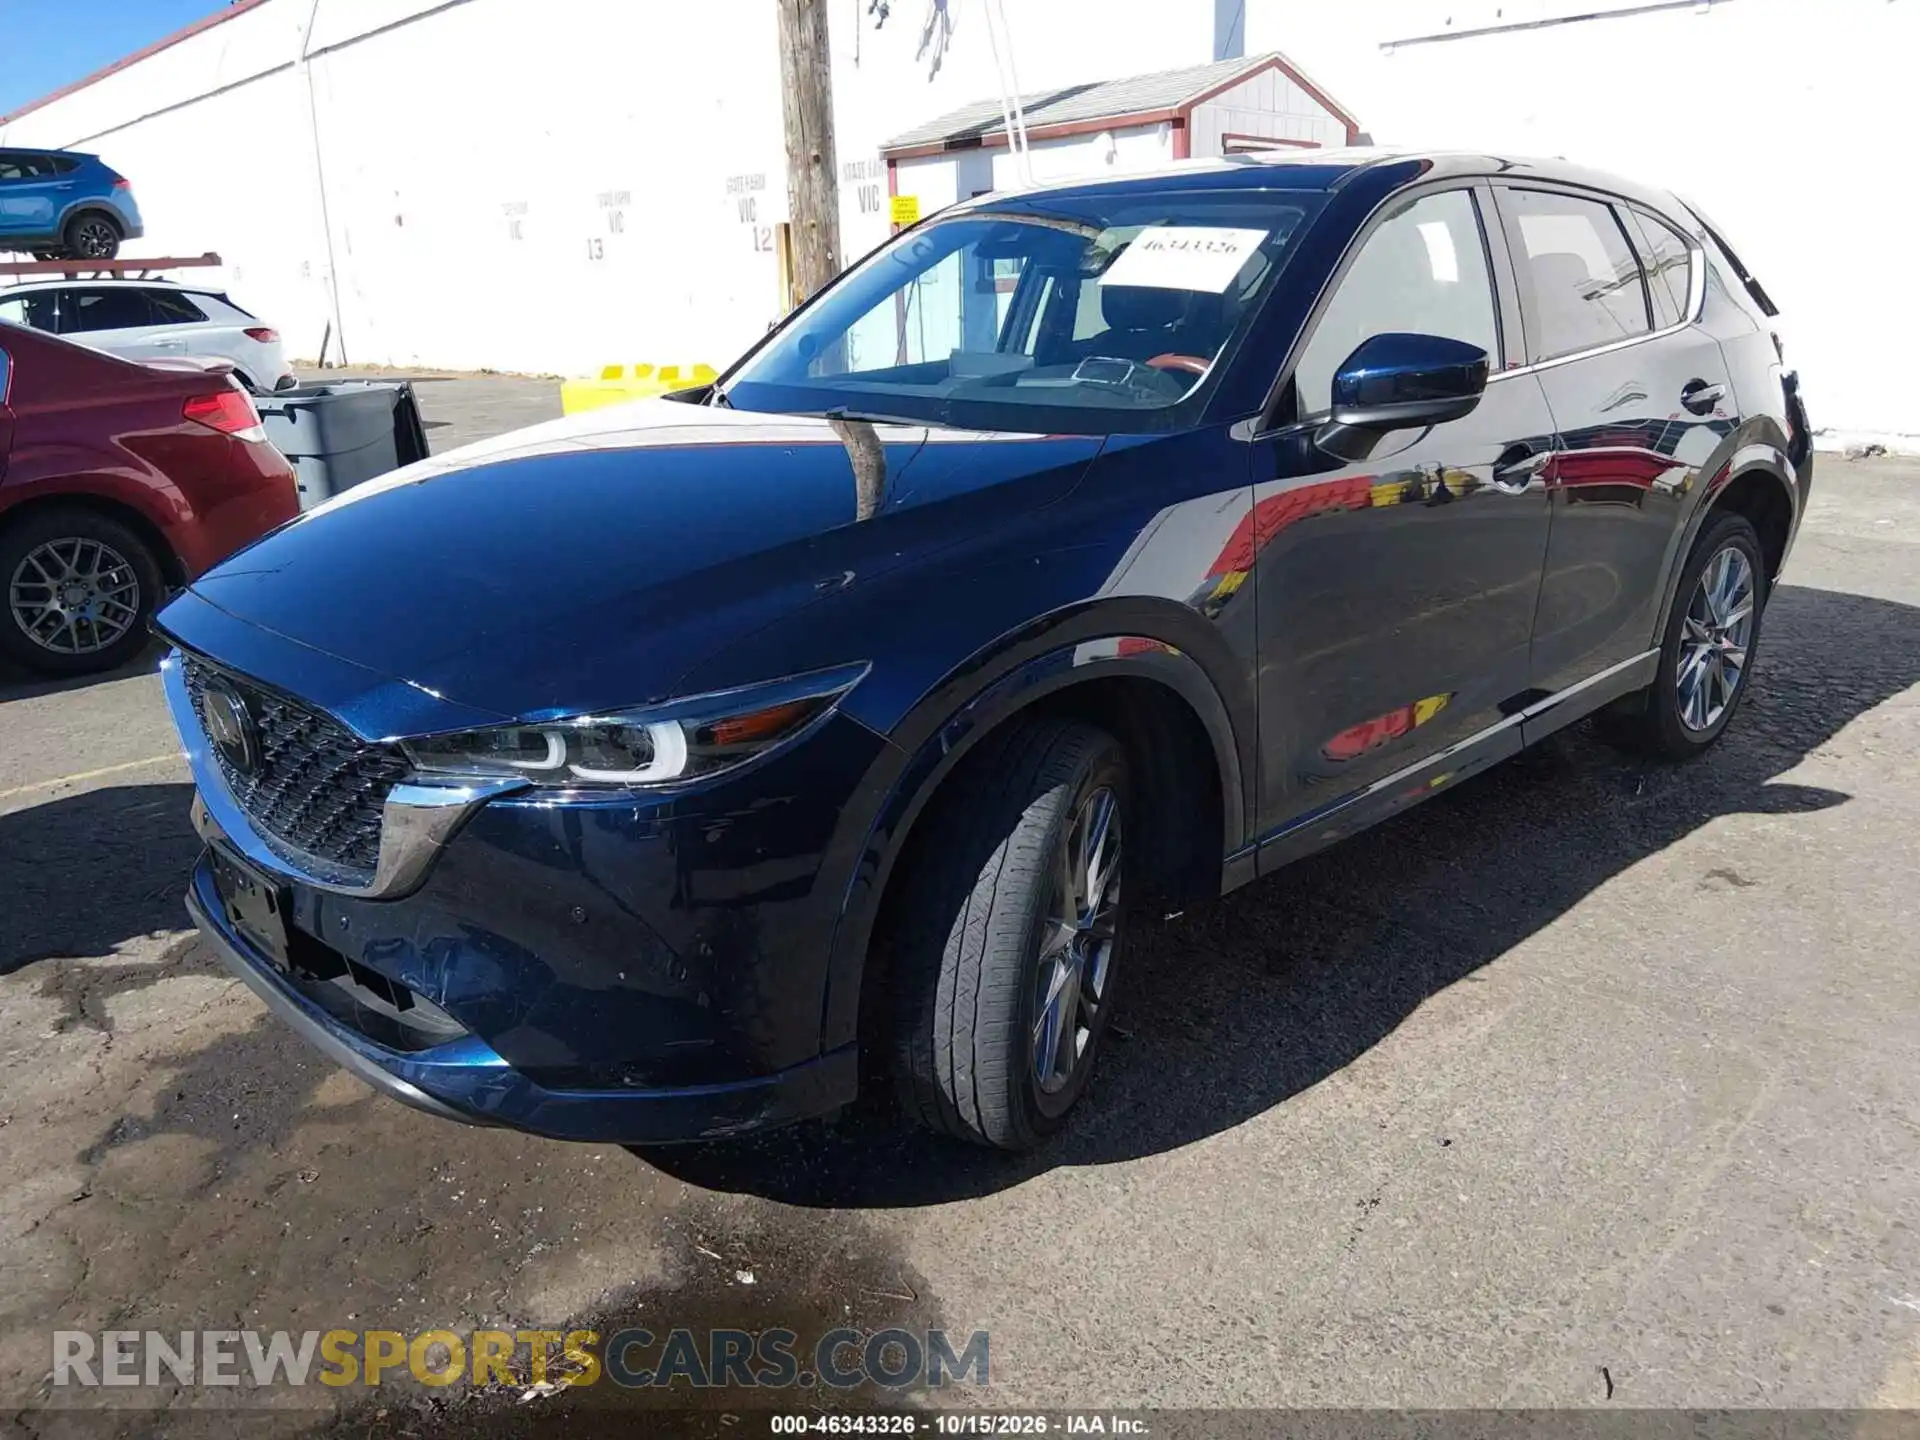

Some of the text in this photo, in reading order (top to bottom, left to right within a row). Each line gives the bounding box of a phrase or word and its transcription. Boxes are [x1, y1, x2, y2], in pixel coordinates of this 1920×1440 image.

[738, 197, 756, 223] VIC
[858, 184, 880, 213] VIC
[587, 237, 604, 261] 13
[753, 226, 773, 251] 12
